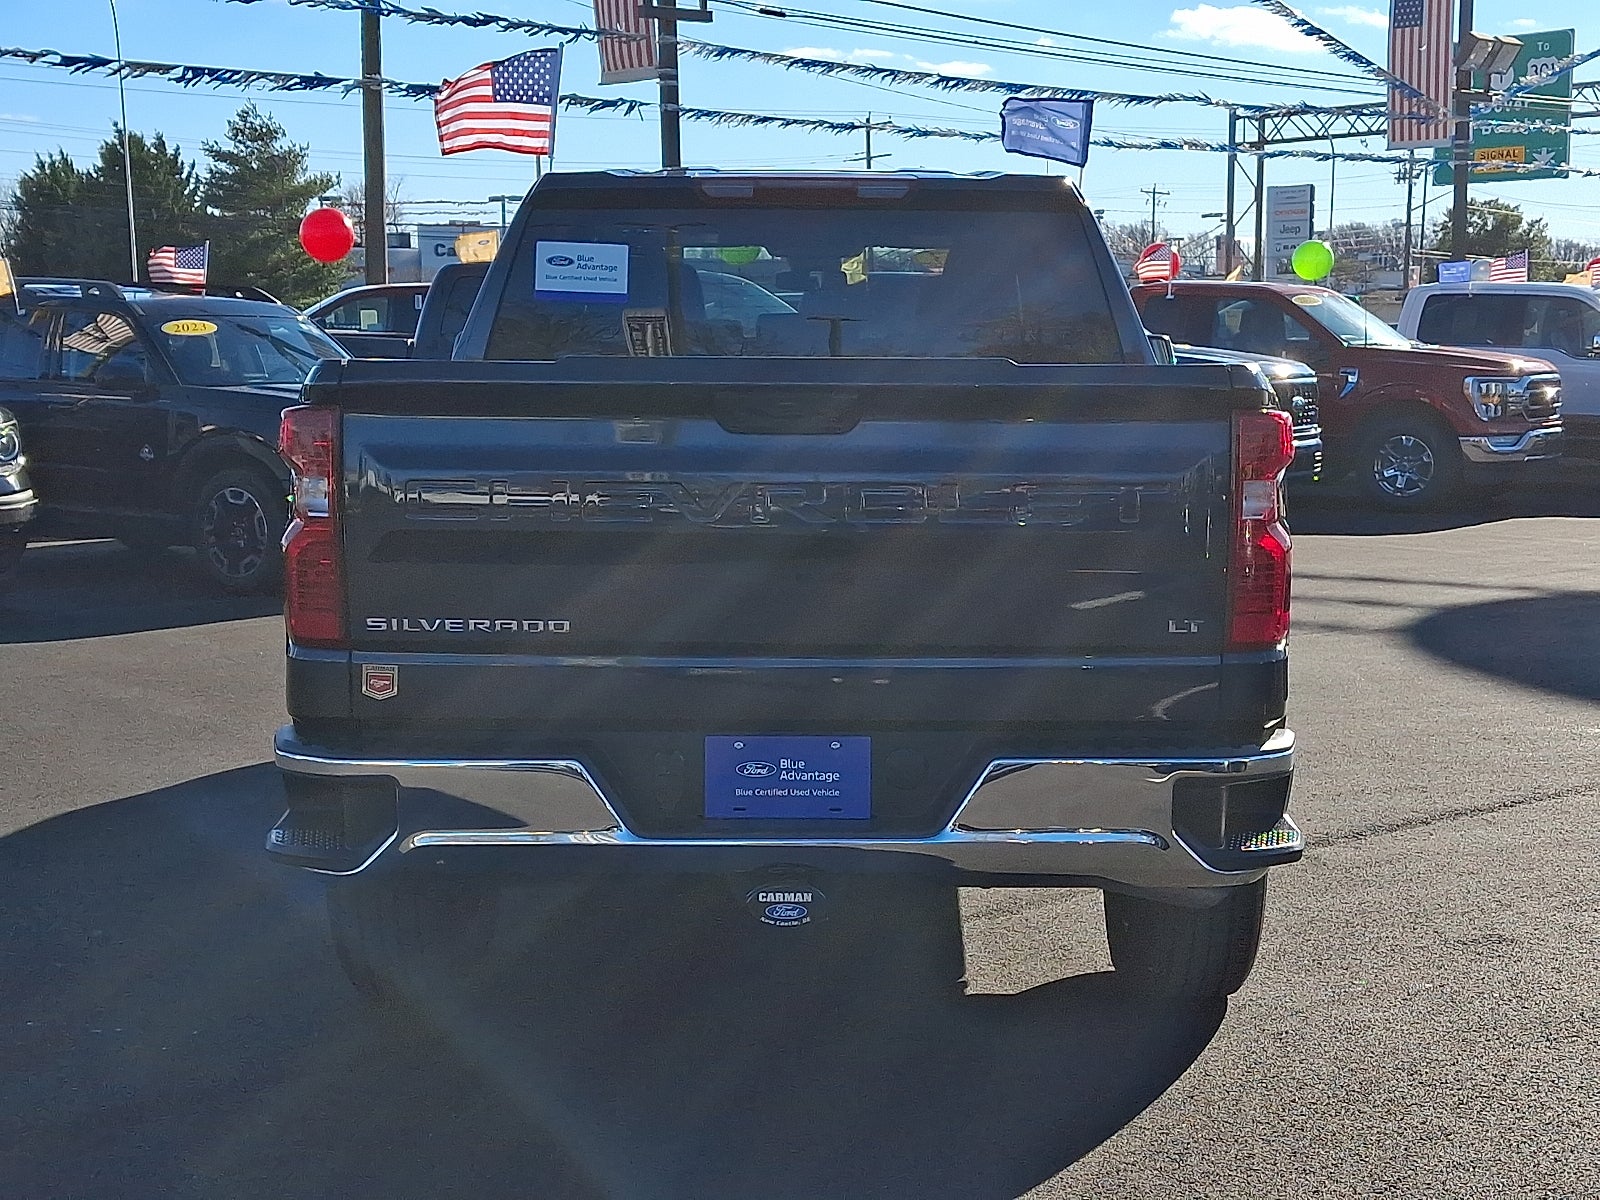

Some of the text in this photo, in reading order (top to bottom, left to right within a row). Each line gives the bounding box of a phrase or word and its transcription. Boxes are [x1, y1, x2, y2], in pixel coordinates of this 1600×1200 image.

[1479, 148, 1519, 160] SIGNAL
[1279, 224, 1301, 236] Jeep
[576, 254, 595, 263] Blue
[576, 263, 618, 273] Advantage
[173, 323, 207, 333] 2023
[366, 617, 570, 633] SILVERADO
[1168, 620, 1205, 633] LT
[740, 762, 773, 776] Ford
[780, 758, 806, 769] Blue
[780, 771, 840, 783] Advantage
[735, 788, 840, 797] Blue Certified Used Vehicle
[758, 892, 813, 902] CARMAN
